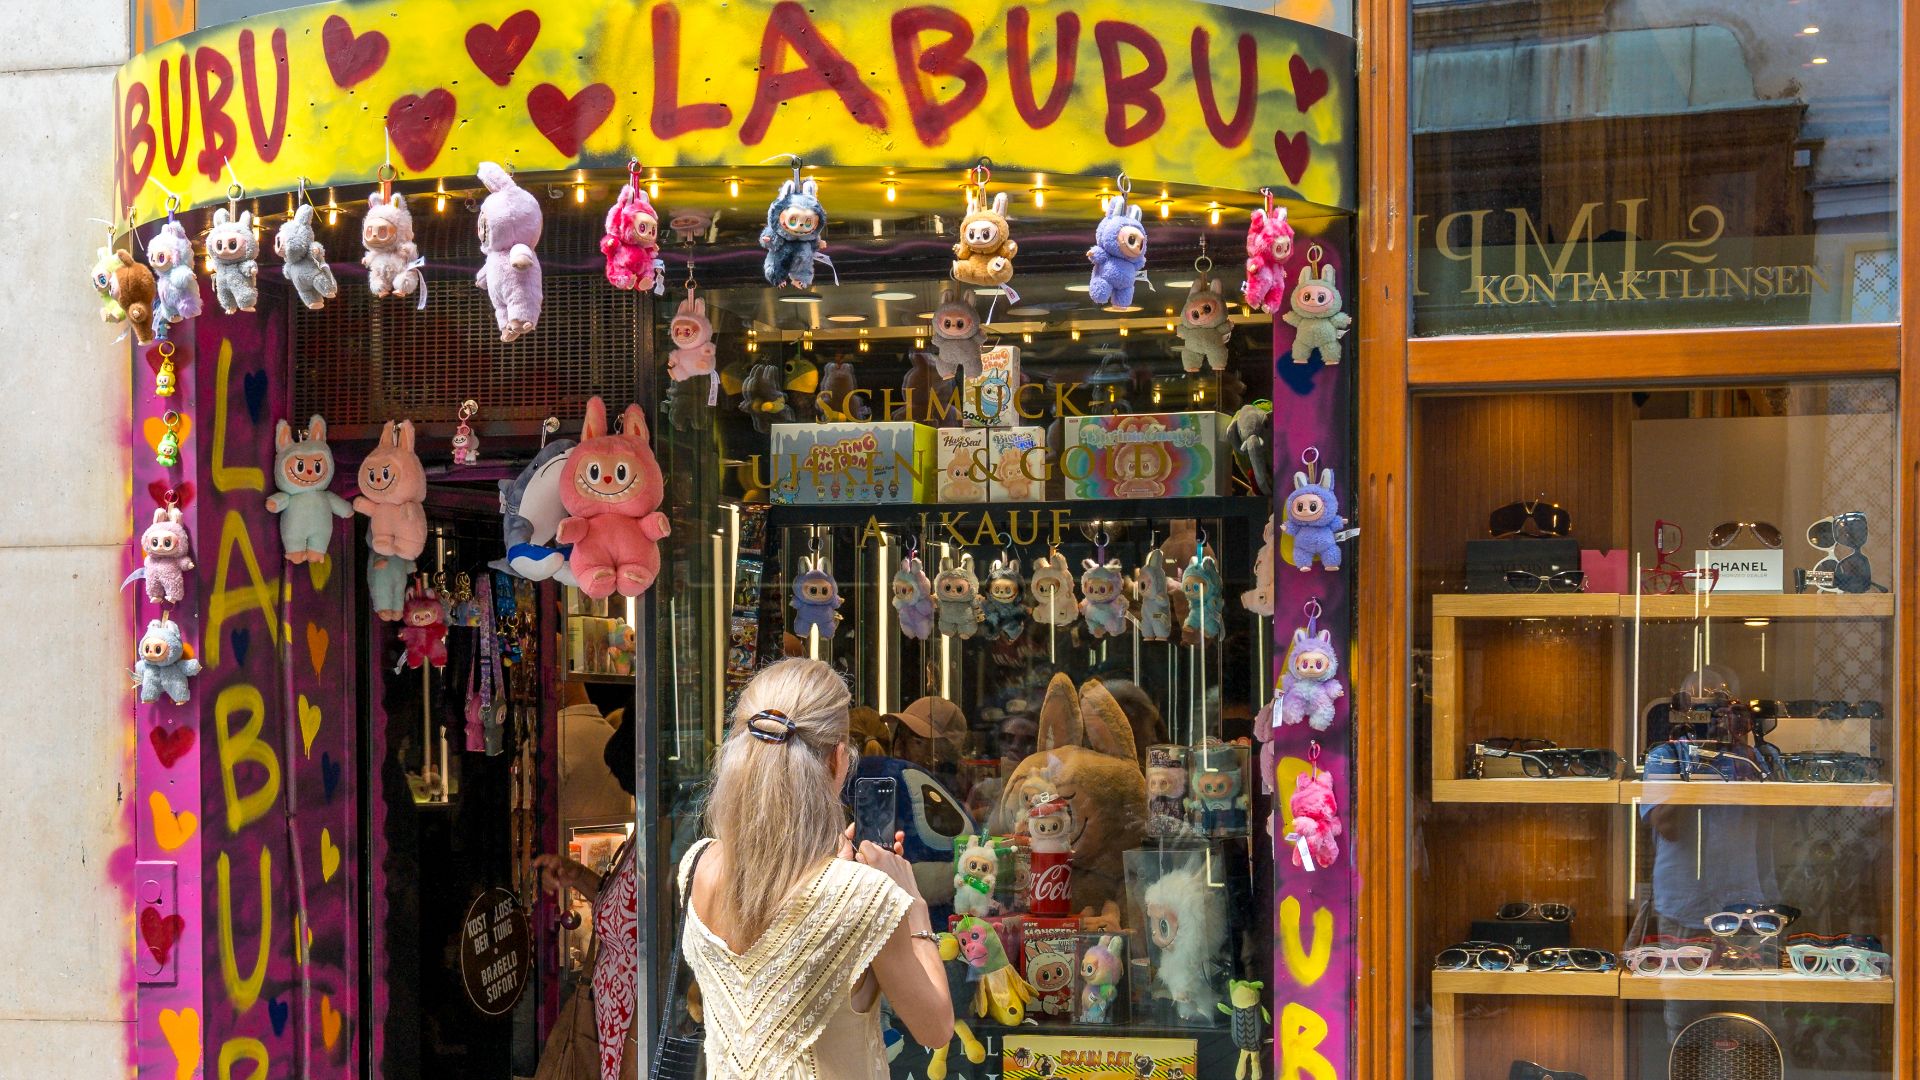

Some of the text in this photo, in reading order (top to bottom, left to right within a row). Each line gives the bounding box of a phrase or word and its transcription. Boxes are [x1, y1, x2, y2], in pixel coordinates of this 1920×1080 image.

[650, 1, 1258, 149] LABUBU
[1474, 264, 1834, 306] KONTAKTLINSEN
[968, 447, 1004, 483] &
[1711, 562, 1768, 572] CHANEL
[486, 970, 518, 1004] SOFORT
[1060, 1049, 1102, 1067] BRAIN
